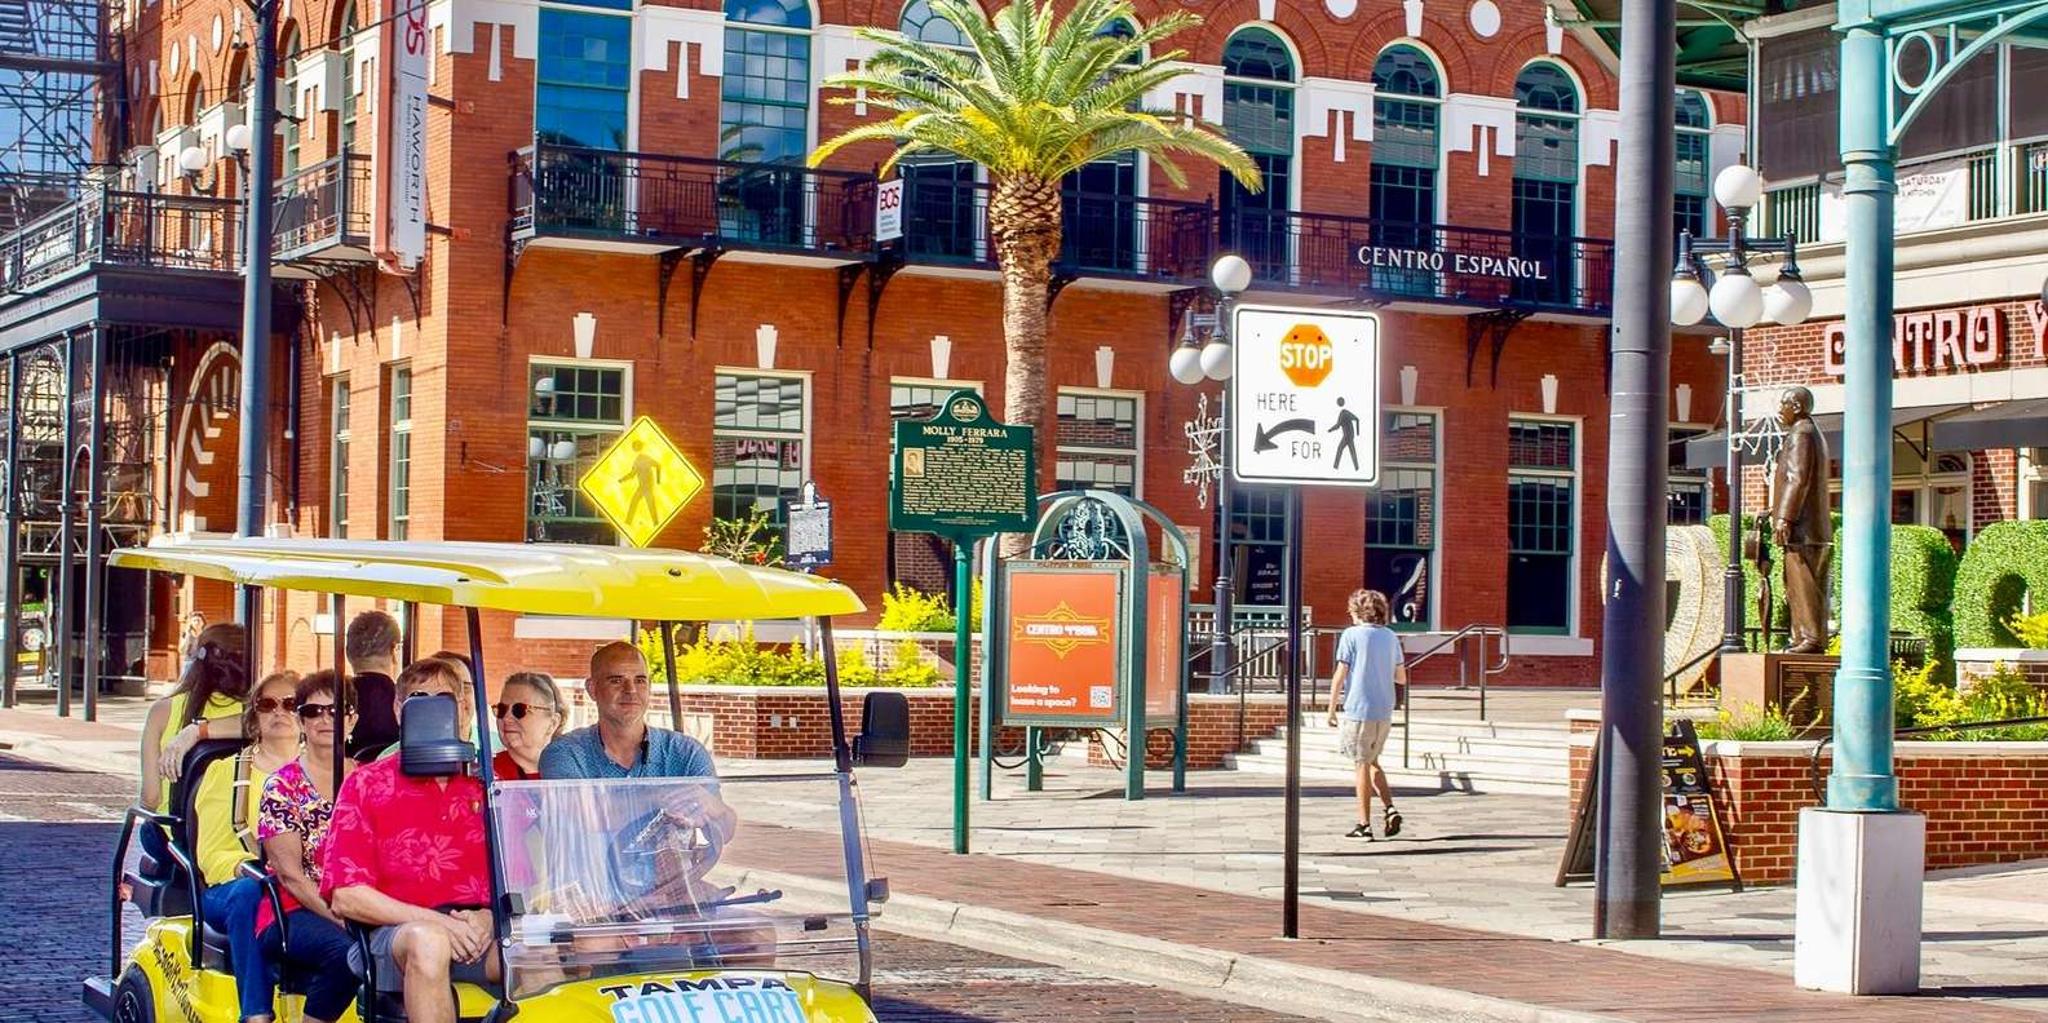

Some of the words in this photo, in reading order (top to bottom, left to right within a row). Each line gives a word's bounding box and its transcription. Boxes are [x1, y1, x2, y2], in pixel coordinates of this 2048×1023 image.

[410, 95, 422, 223] HAWORTH
[880, 186, 900, 210] BOS
[1358, 246, 1444, 271] CENTRO
[1455, 254, 1547, 280] ESPAÑOL
[1824, 307, 2000, 376] CTRO
[1280, 342, 1333, 370] STOP
[1256, 392, 1298, 412] HERE
[922, 425, 956, 436] MOLLY
[961, 426, 1008, 438] FERRARA
[1291, 440, 1322, 460] FOR
[1026, 623, 1063, 635] CENTRO
[1011, 683, 1048, 696] Looking
[1049, 685, 1060, 695] to
[1010, 696, 1035, 706] lease
[1044, 697, 1077, 708] space?
[600, 977, 793, 1001] TAMPA
[613, 992, 705, 1023] GOLF
[712, 990, 808, 1023] CART
